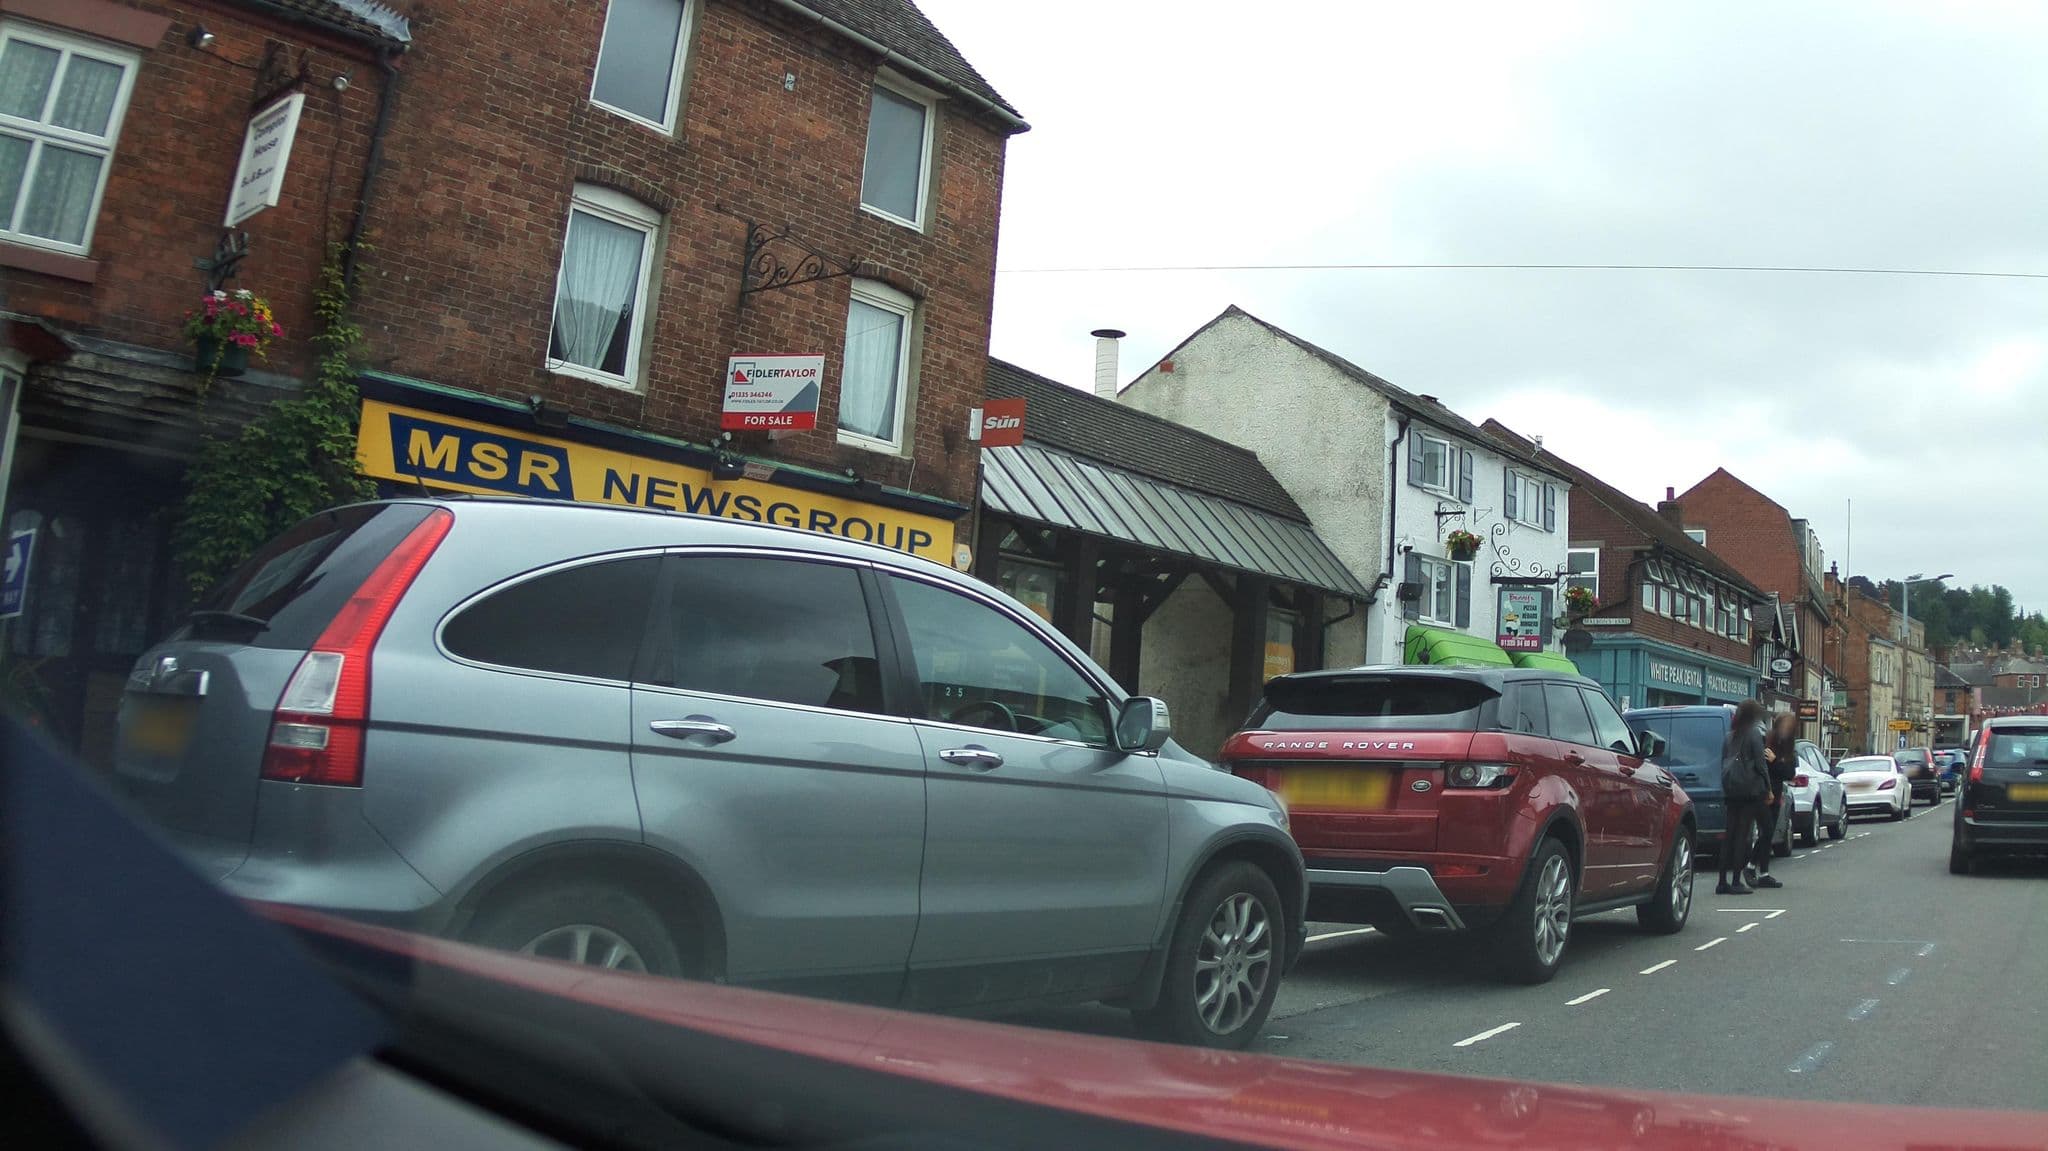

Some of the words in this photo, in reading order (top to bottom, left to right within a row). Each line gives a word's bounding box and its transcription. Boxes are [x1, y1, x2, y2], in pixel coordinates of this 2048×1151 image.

[746, 368, 817, 378] FIDLERTAYLOR
[744, 416, 767, 425] FOR
[767, 416, 793, 425] SALE
[406, 428, 561, 492] MSR
[602, 467, 934, 556] NEWSGROUP
[1650, 661, 1668, 682] WHITE
[1669, 665, 1684, 684] PEAK
[1684, 668, 1702, 688] DENTAL
[1707, 674, 1727, 694] PRACTICE
[1343, 742, 1414, 750] ROVER
